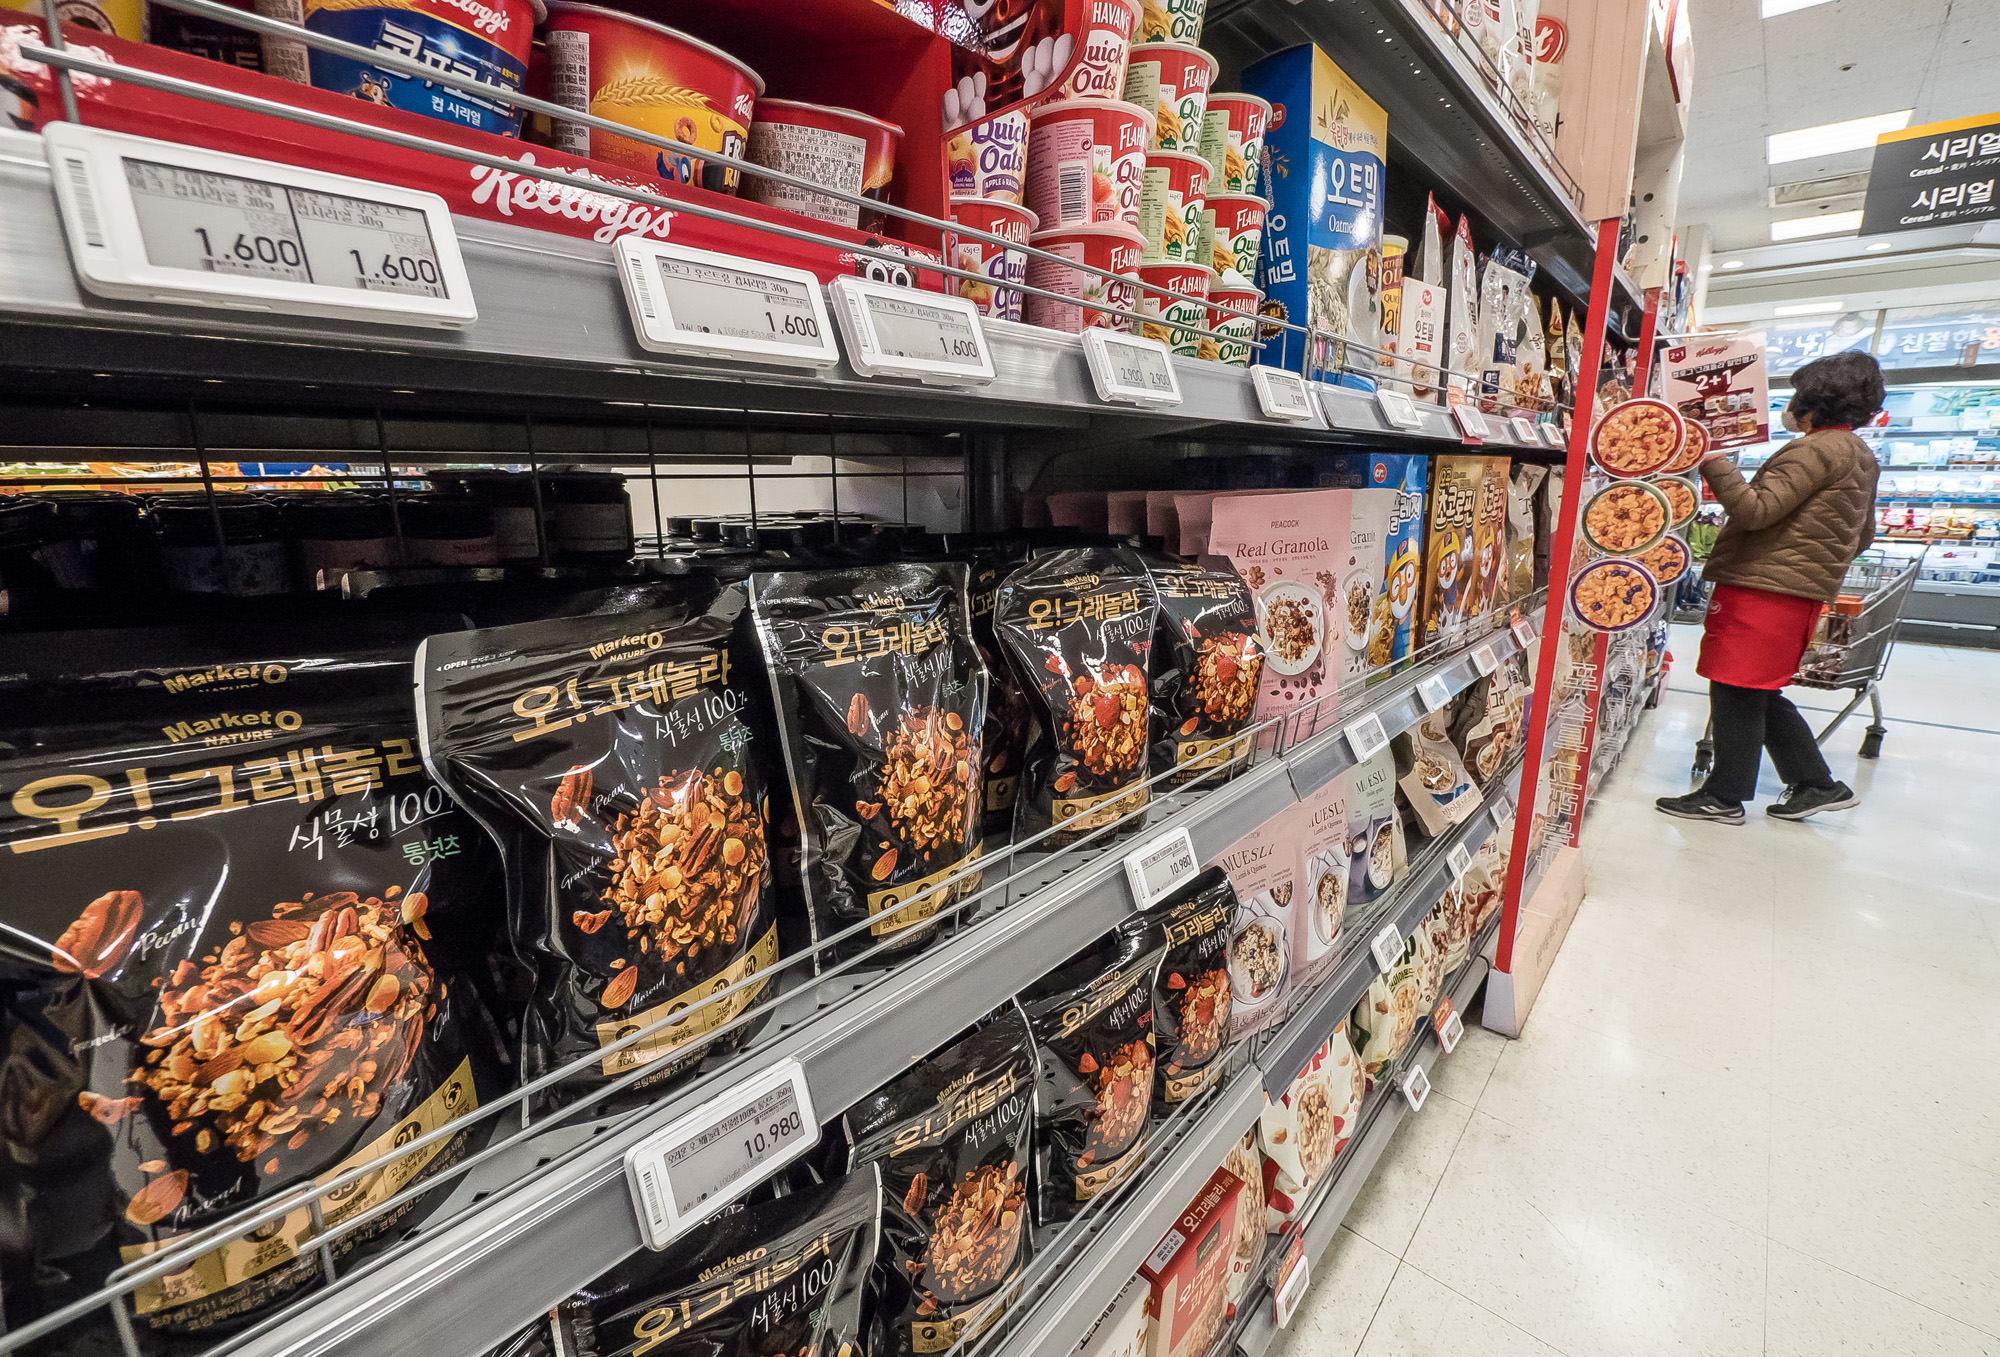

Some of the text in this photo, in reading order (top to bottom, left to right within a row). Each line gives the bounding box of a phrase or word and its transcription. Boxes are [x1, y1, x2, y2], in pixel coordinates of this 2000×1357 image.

[1086, 40, 1124, 70] uick
[1072, 68, 1117, 93] Oats
[431, 95, 481, 127] 컵 시리얼
[971, 117, 1027, 151] Quick
[1920, 132, 2000, 163] 시리얼
[980, 145, 1023, 174] Oats
[1909, 165, 1945, 178] Cereal
[470, 151, 675, 244] Kellogg's
[985, 177, 1001, 190] APPLE
[1327, 158, 1378, 221] 오트밀
[1911, 179, 1995, 211] 시리얼
[1900, 212, 1934, 225] Cereal
[770, 282, 789, 295] 30g
[1415, 320, 1435, 343] 오트밀
[1219, 342, 1250, 361] Oats
[1669, 350, 1685, 360] 2+1
[1695, 345, 1729, 358] Kellogg's
[1696, 369, 1732, 391] 2+1
[1270, 520, 1300, 529] PEACOCK
[1235, 537, 1330, 558] Real Granola
[1026, 588, 1140, 631] 오!그래놀라
[609, 648, 646, 663] NATURE
[822, 616, 948, 668] 오!그래놀라
[443, 659, 469, 671] OPEN
[512, 649, 732, 743] 오!그래놀라
[204, 729, 274, 747] NATURE
[655, 707, 705, 748] 식물성
[592, 781, 627, 815] Pecan
[288, 806, 381, 861] 식물성
[401, 834, 463, 867] 통넛츠
[1222, 843, 1275, 875] MUESLI
[1167, 903, 1228, 952] !그래놀라
[889, 1067, 1018, 1158] 오!그래놀라
[964, 1114, 997, 1149] 식물성
[1182, 1183, 1227, 1233] 오!그래놀라
[632, 1232, 830, 1357] 오!그래놀라
[751, 1284, 798, 1333] 식물성
